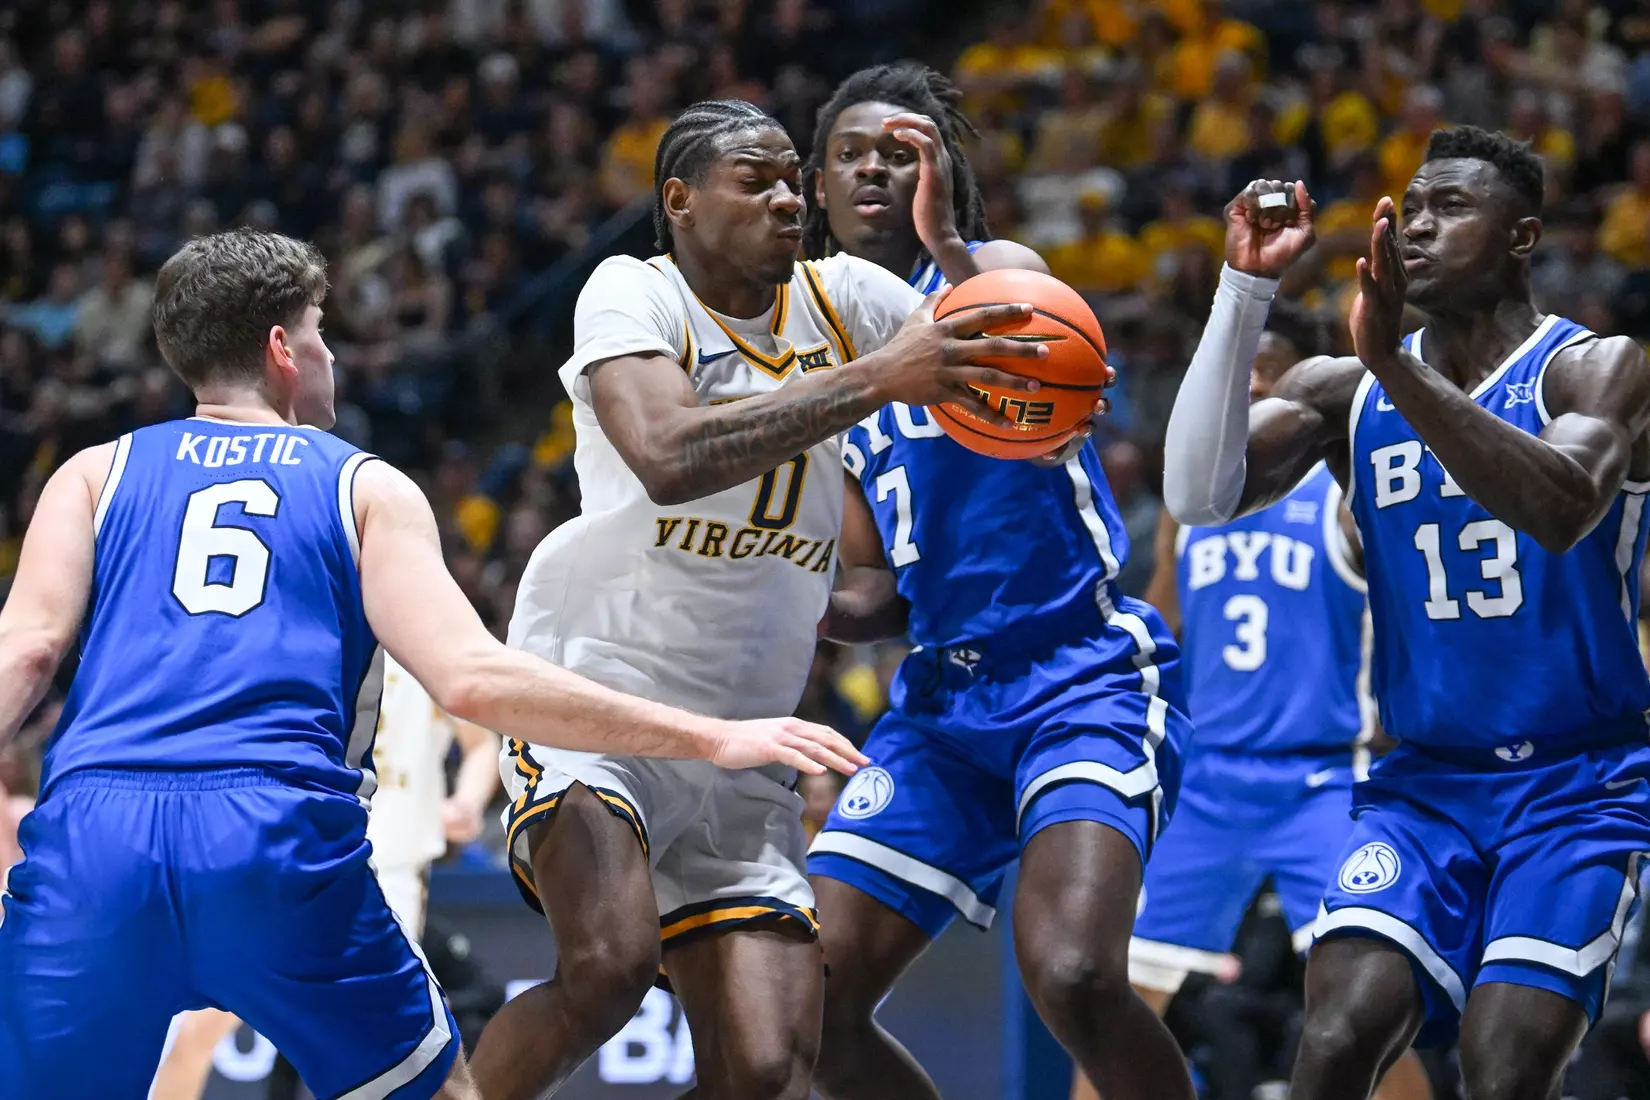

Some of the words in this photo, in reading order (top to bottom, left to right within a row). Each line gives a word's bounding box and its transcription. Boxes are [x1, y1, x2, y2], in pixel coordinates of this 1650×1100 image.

[797, 346, 834, 373] XII
[965, 384, 1056, 425] ITE
[176, 432, 309, 468] KOSTIC
[748, 450, 811, 531] 0
[876, 464, 922, 569] 7
[169, 478, 282, 620] 6
[654, 516, 837, 574] VIRGINIA
[1187, 528, 1316, 593] BYU
[1413, 518, 1525, 620] 13
[1222, 593, 1269, 672] 3
